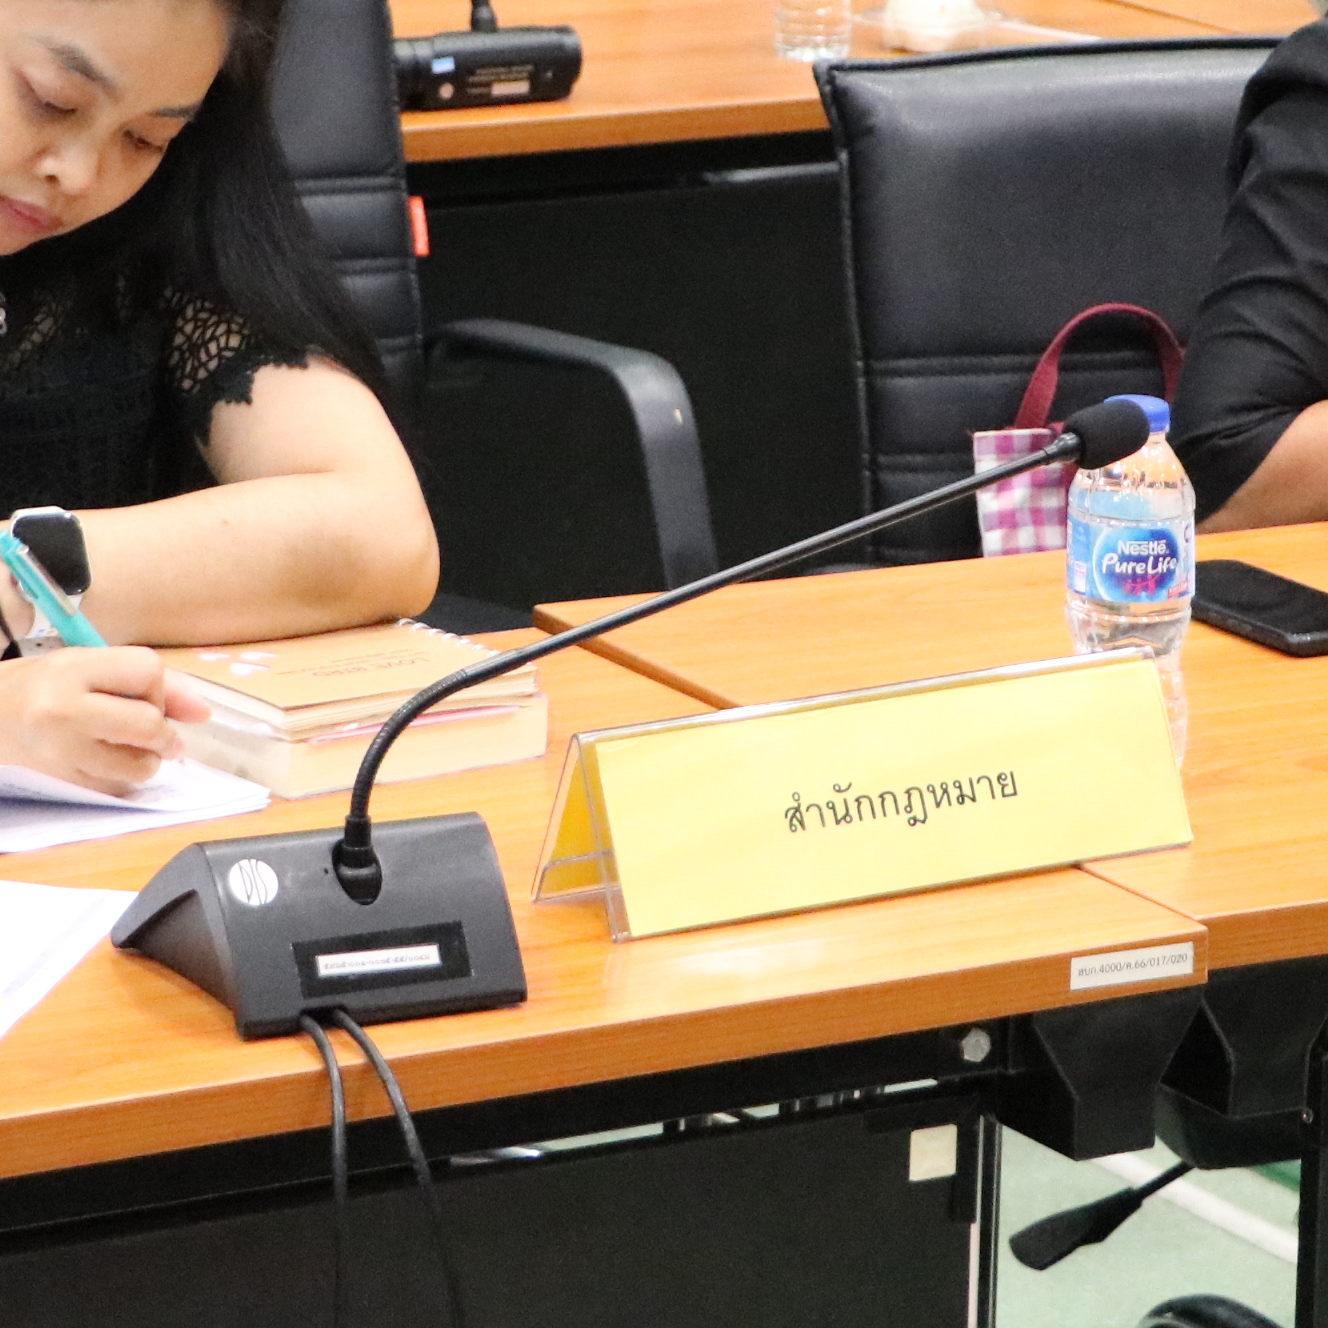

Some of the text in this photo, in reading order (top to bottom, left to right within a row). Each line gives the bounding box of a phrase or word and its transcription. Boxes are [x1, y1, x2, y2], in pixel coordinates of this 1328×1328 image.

[1117, 539, 1167, 556] Nestlé
[784, 771, 1018, 833] สำนักกฎหมาย
